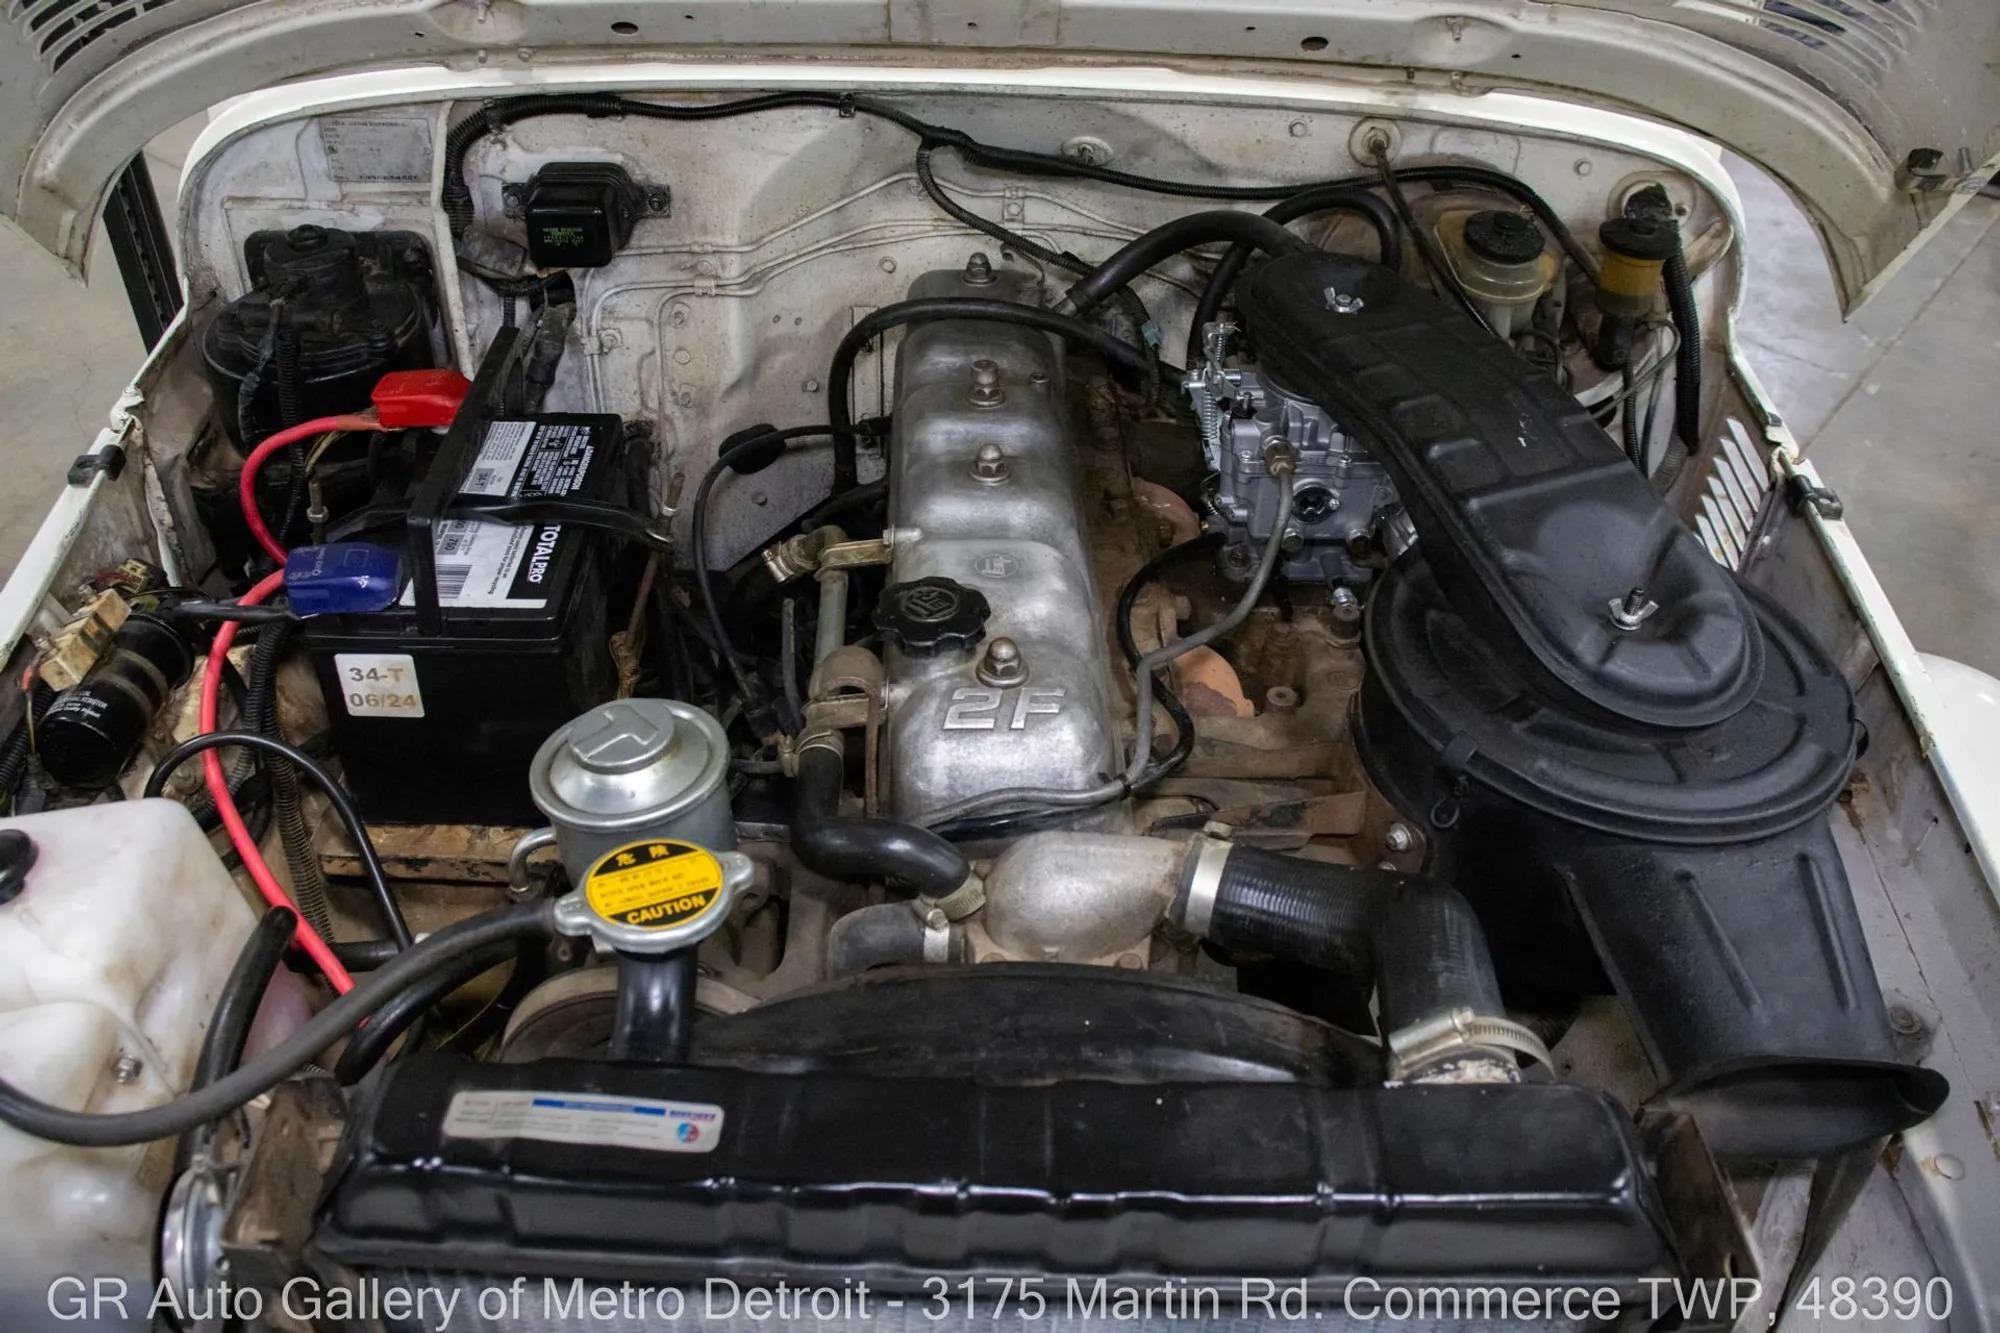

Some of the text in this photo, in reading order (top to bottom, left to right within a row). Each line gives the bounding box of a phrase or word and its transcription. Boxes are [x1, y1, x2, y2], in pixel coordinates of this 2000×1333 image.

[528, 524, 561, 584] TOTALPRO
[349, 667, 404, 682] 34-T
[349, 693, 417, 708] 06/24
[942, 687, 1065, 731] 2F
[627, 895, 706, 924] CAUTION
